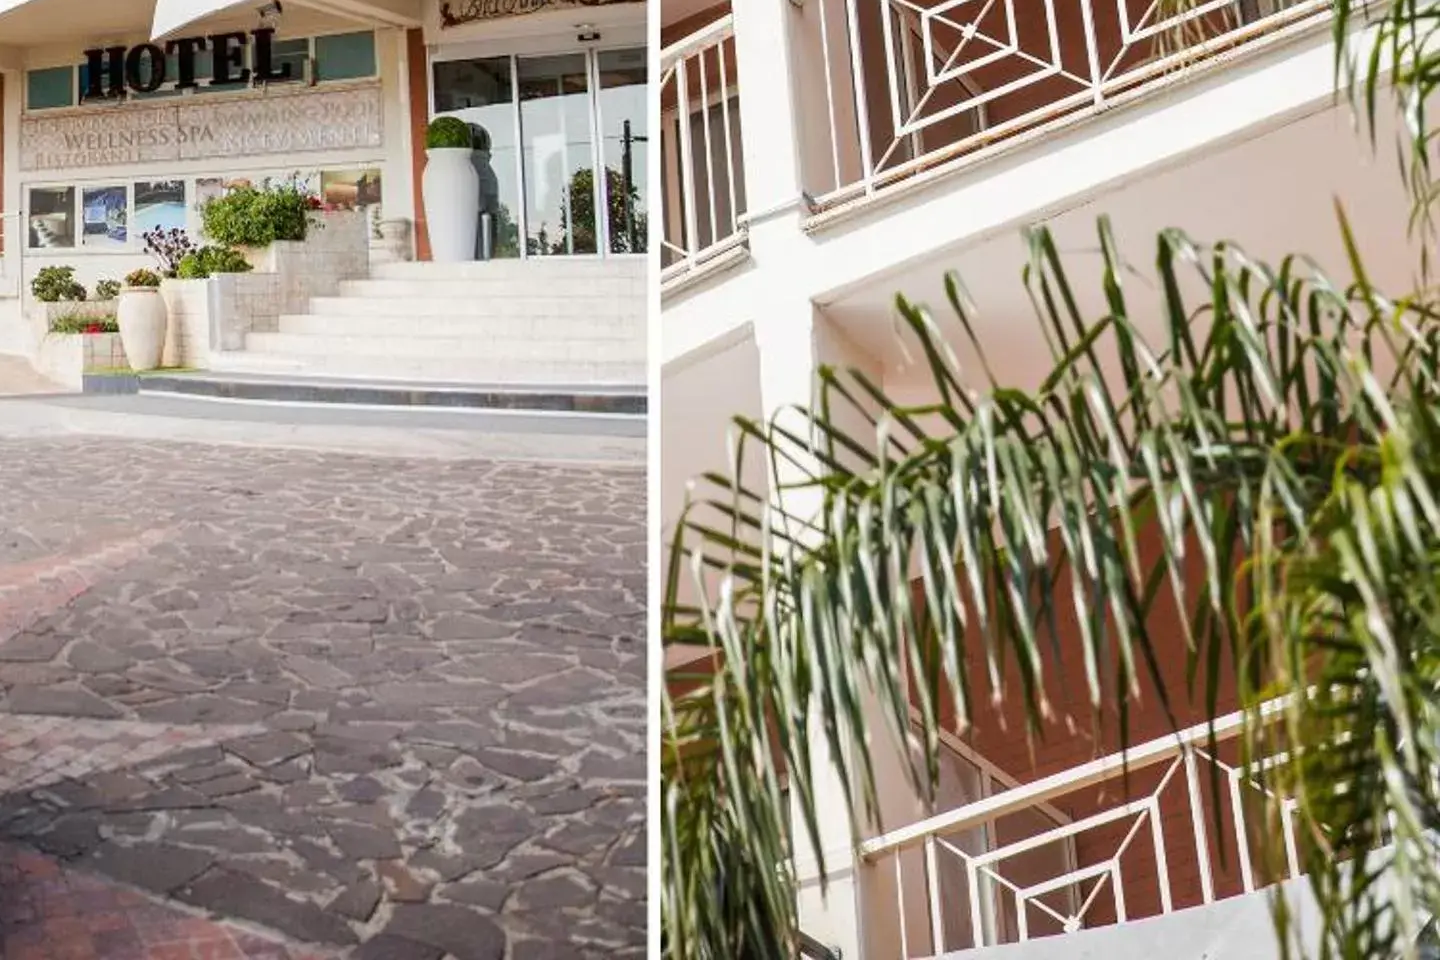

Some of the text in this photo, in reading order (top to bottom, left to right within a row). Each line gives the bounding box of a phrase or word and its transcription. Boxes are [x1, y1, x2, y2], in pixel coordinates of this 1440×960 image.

[84, 28, 292, 97] HOTEL
[63, 123, 215, 151] WELLNESS SPA
